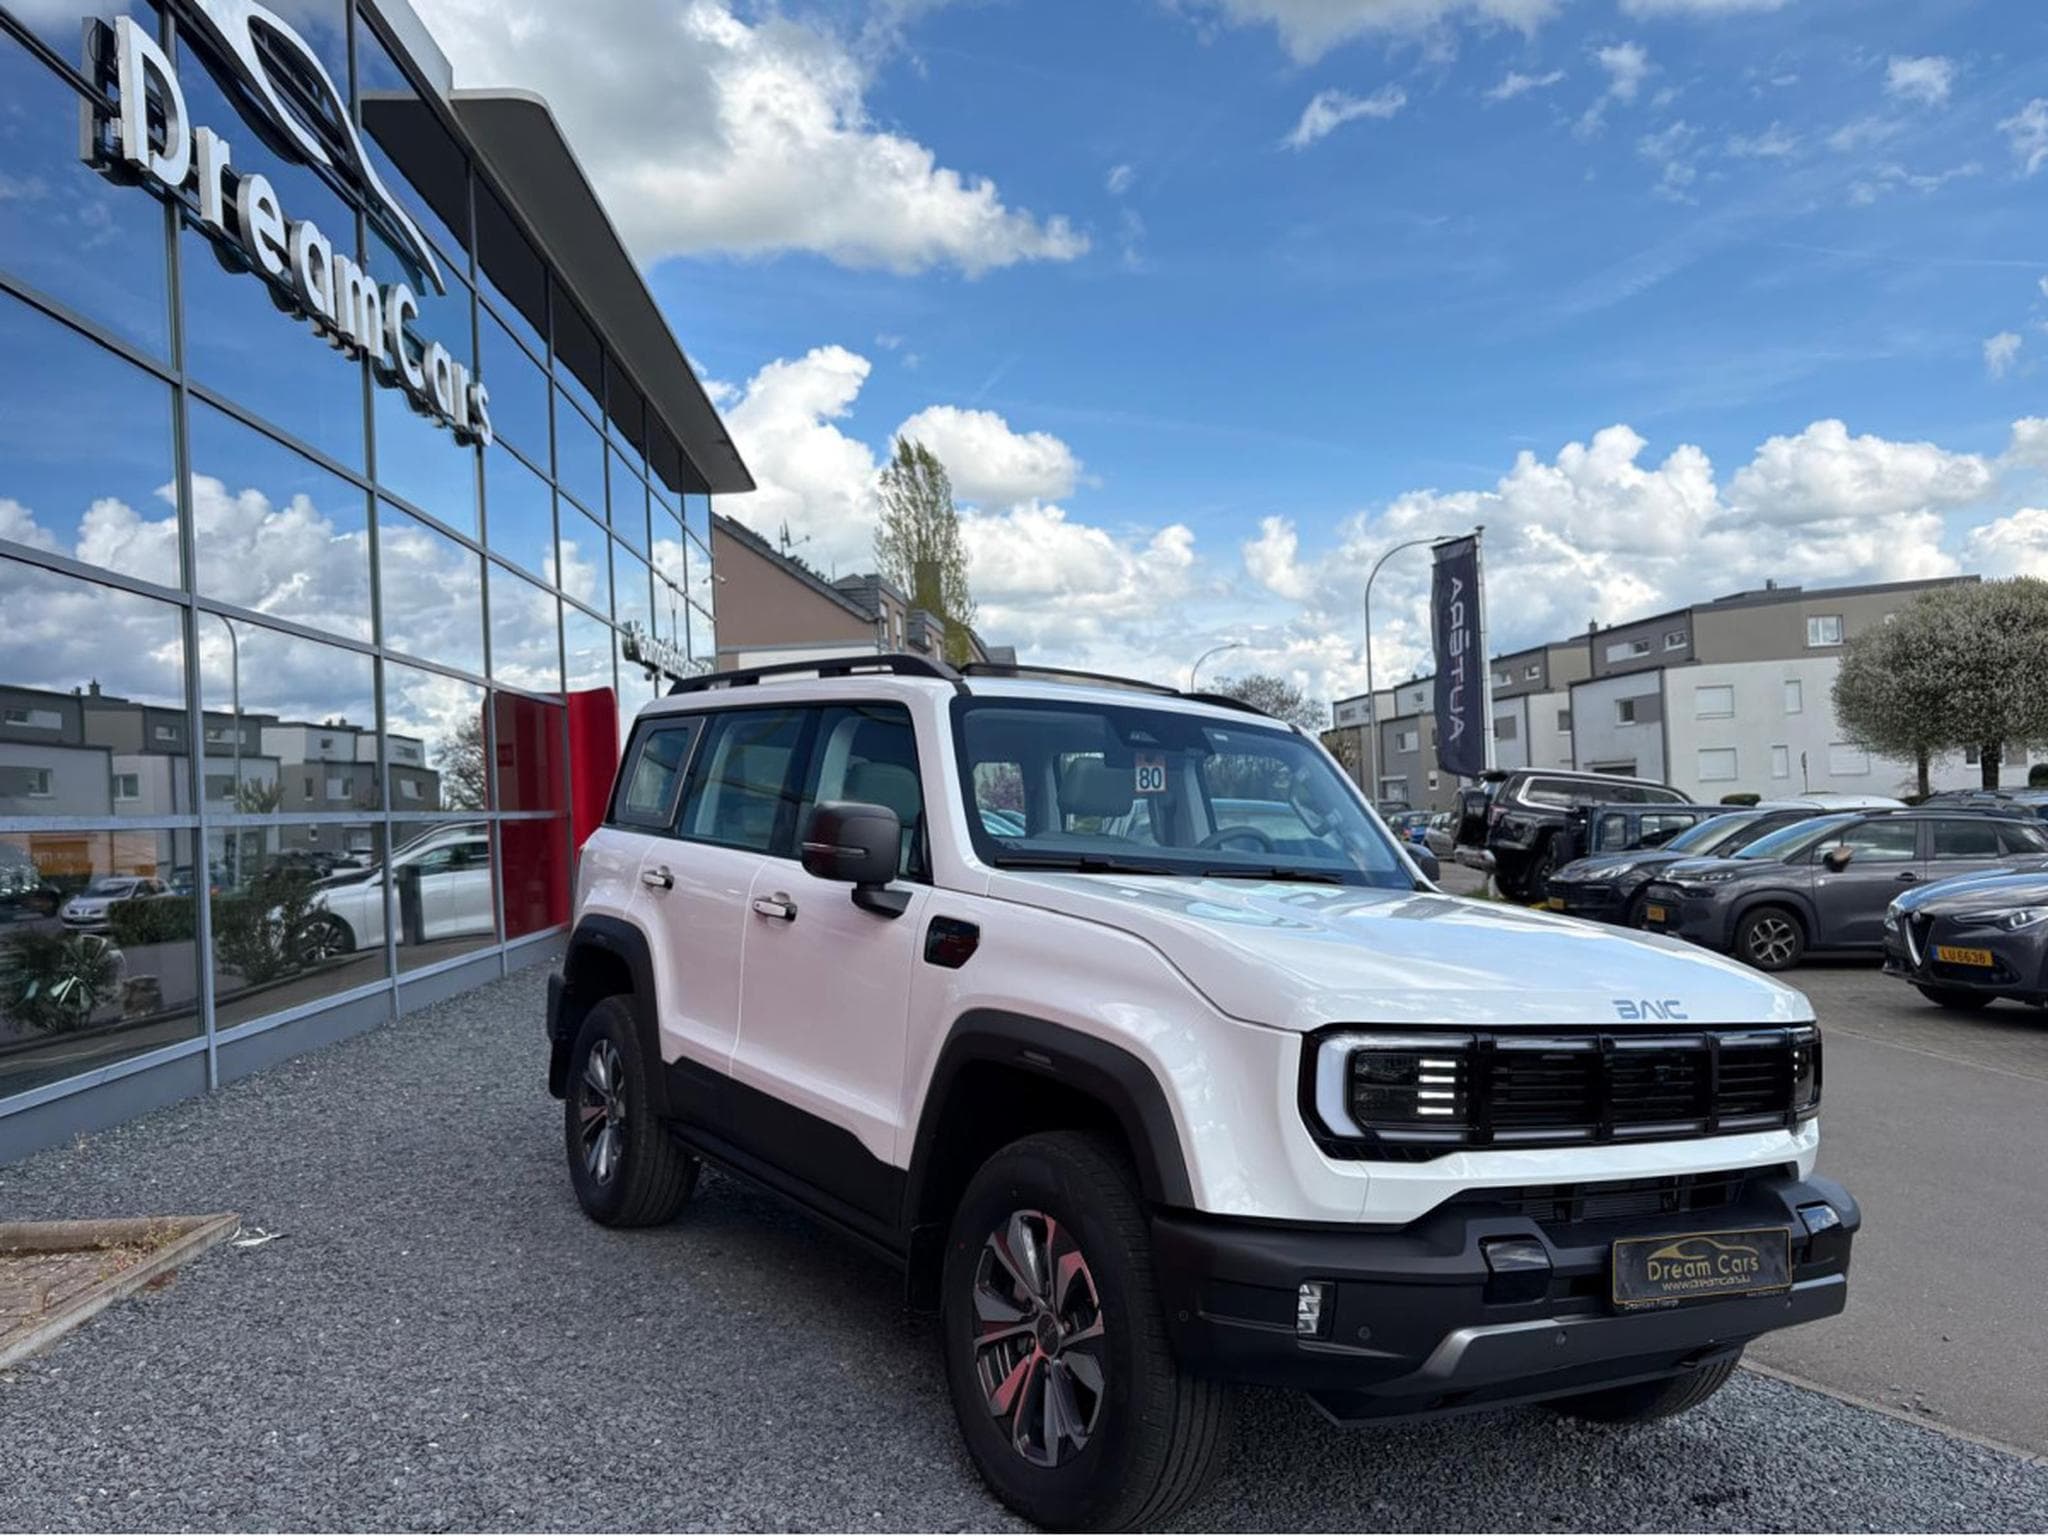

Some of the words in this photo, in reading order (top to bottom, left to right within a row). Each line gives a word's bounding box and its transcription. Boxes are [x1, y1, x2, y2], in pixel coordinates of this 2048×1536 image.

[1139, 767, 1162, 790] 80
[1612, 999, 1689, 1020] BAIC
[1647, 1259, 1712, 1282] Dream
[1717, 1254, 1760, 1275] Cars
